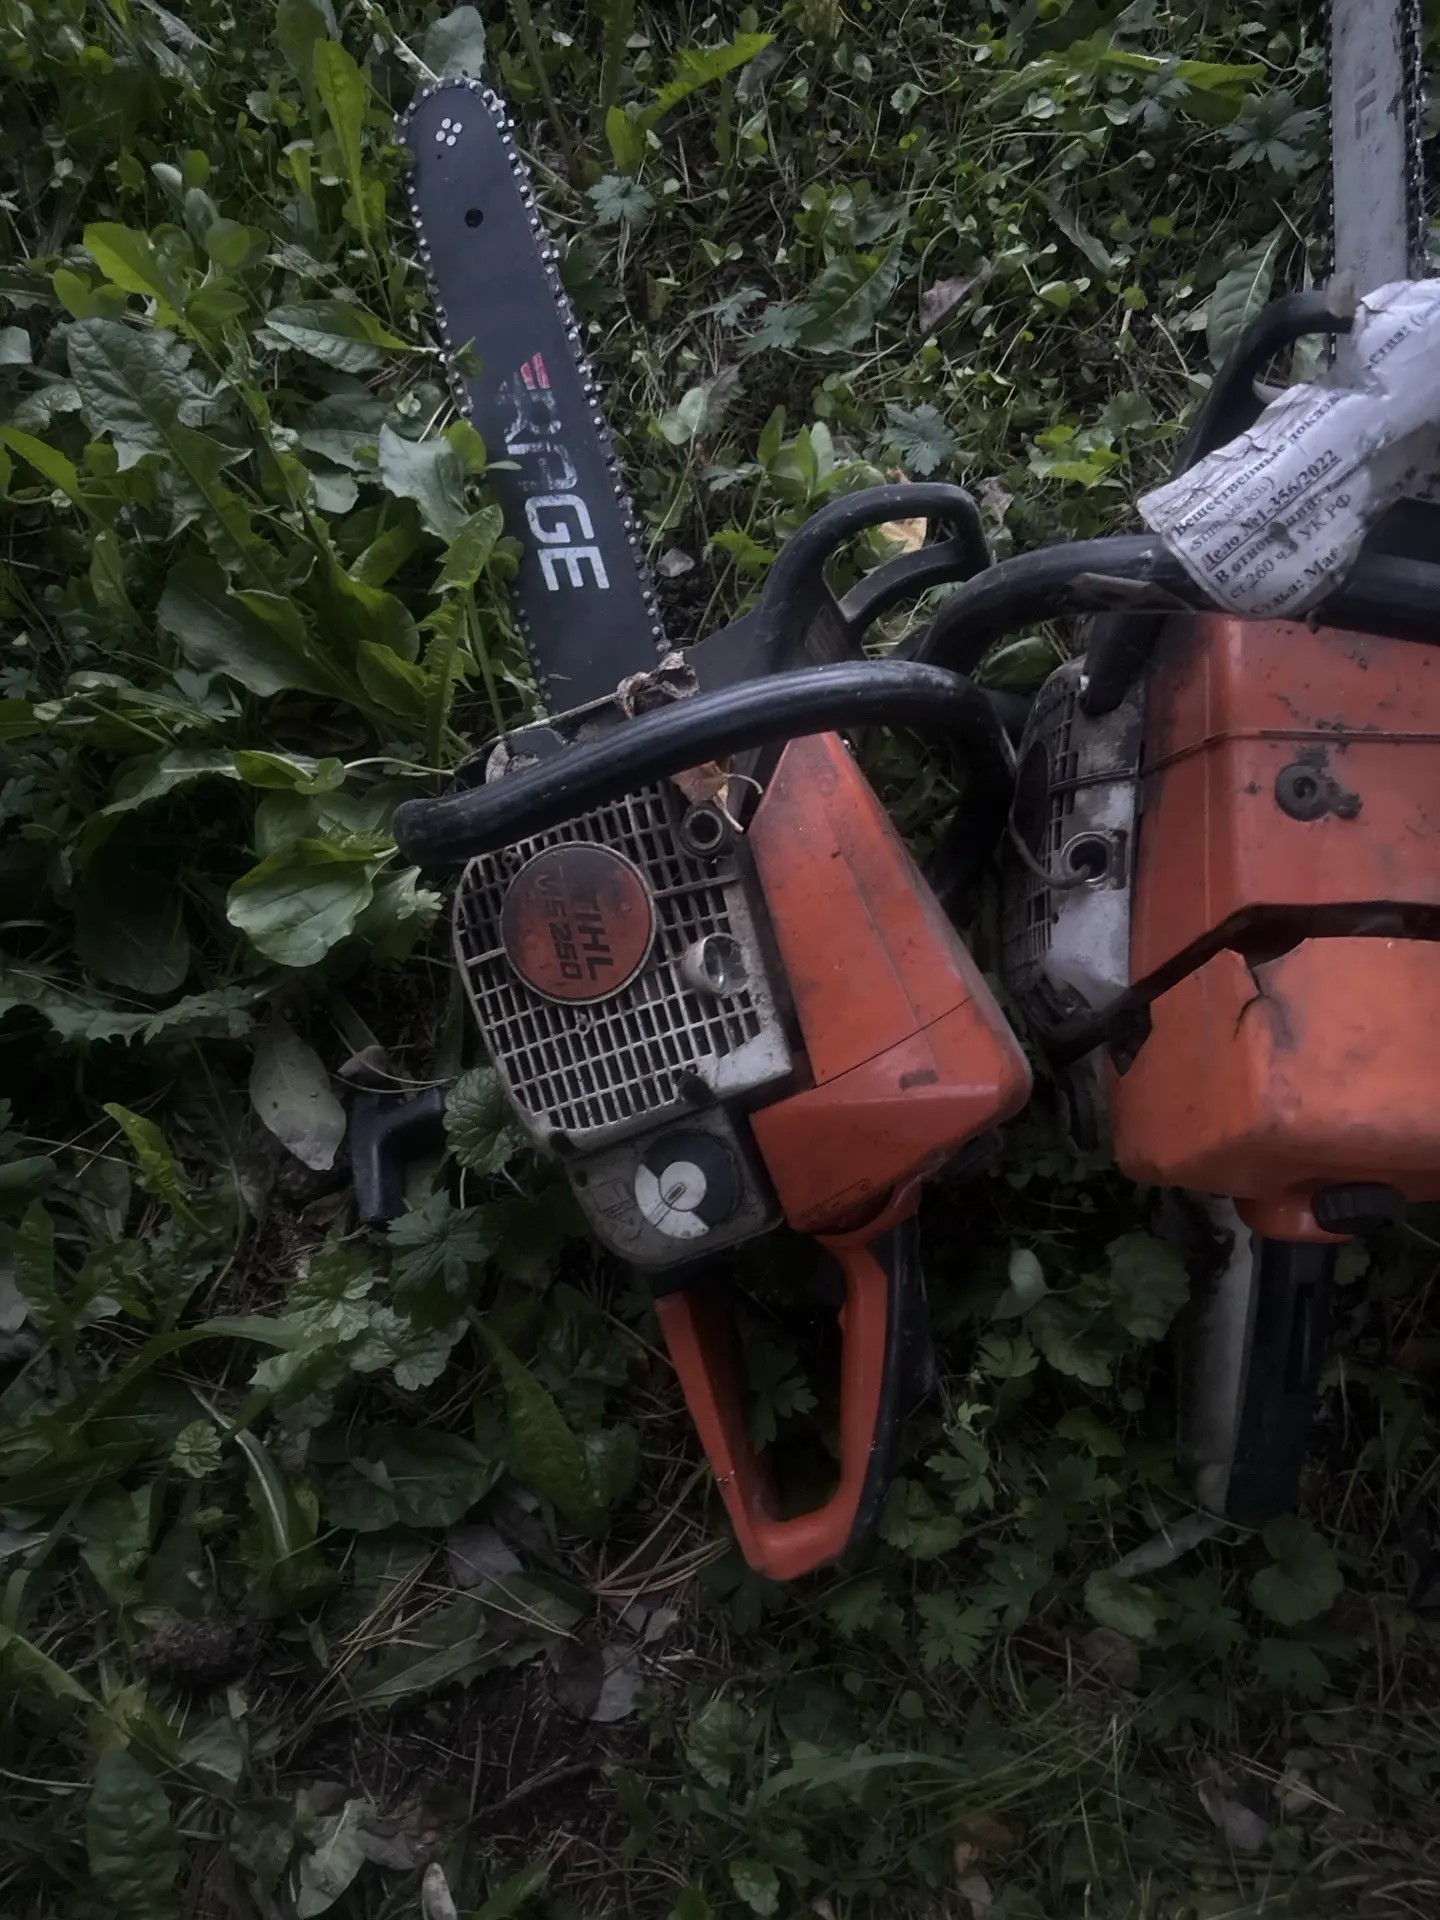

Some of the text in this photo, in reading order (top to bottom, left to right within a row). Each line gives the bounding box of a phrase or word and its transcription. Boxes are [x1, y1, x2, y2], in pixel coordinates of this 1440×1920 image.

[1298, 519, 1326, 541] УК
[1325, 494, 1351, 519] РФ
[1201, 535, 1240, 568] Дело
[549, 922, 585, 980] 250
[572, 876, 614, 981] TIHL
